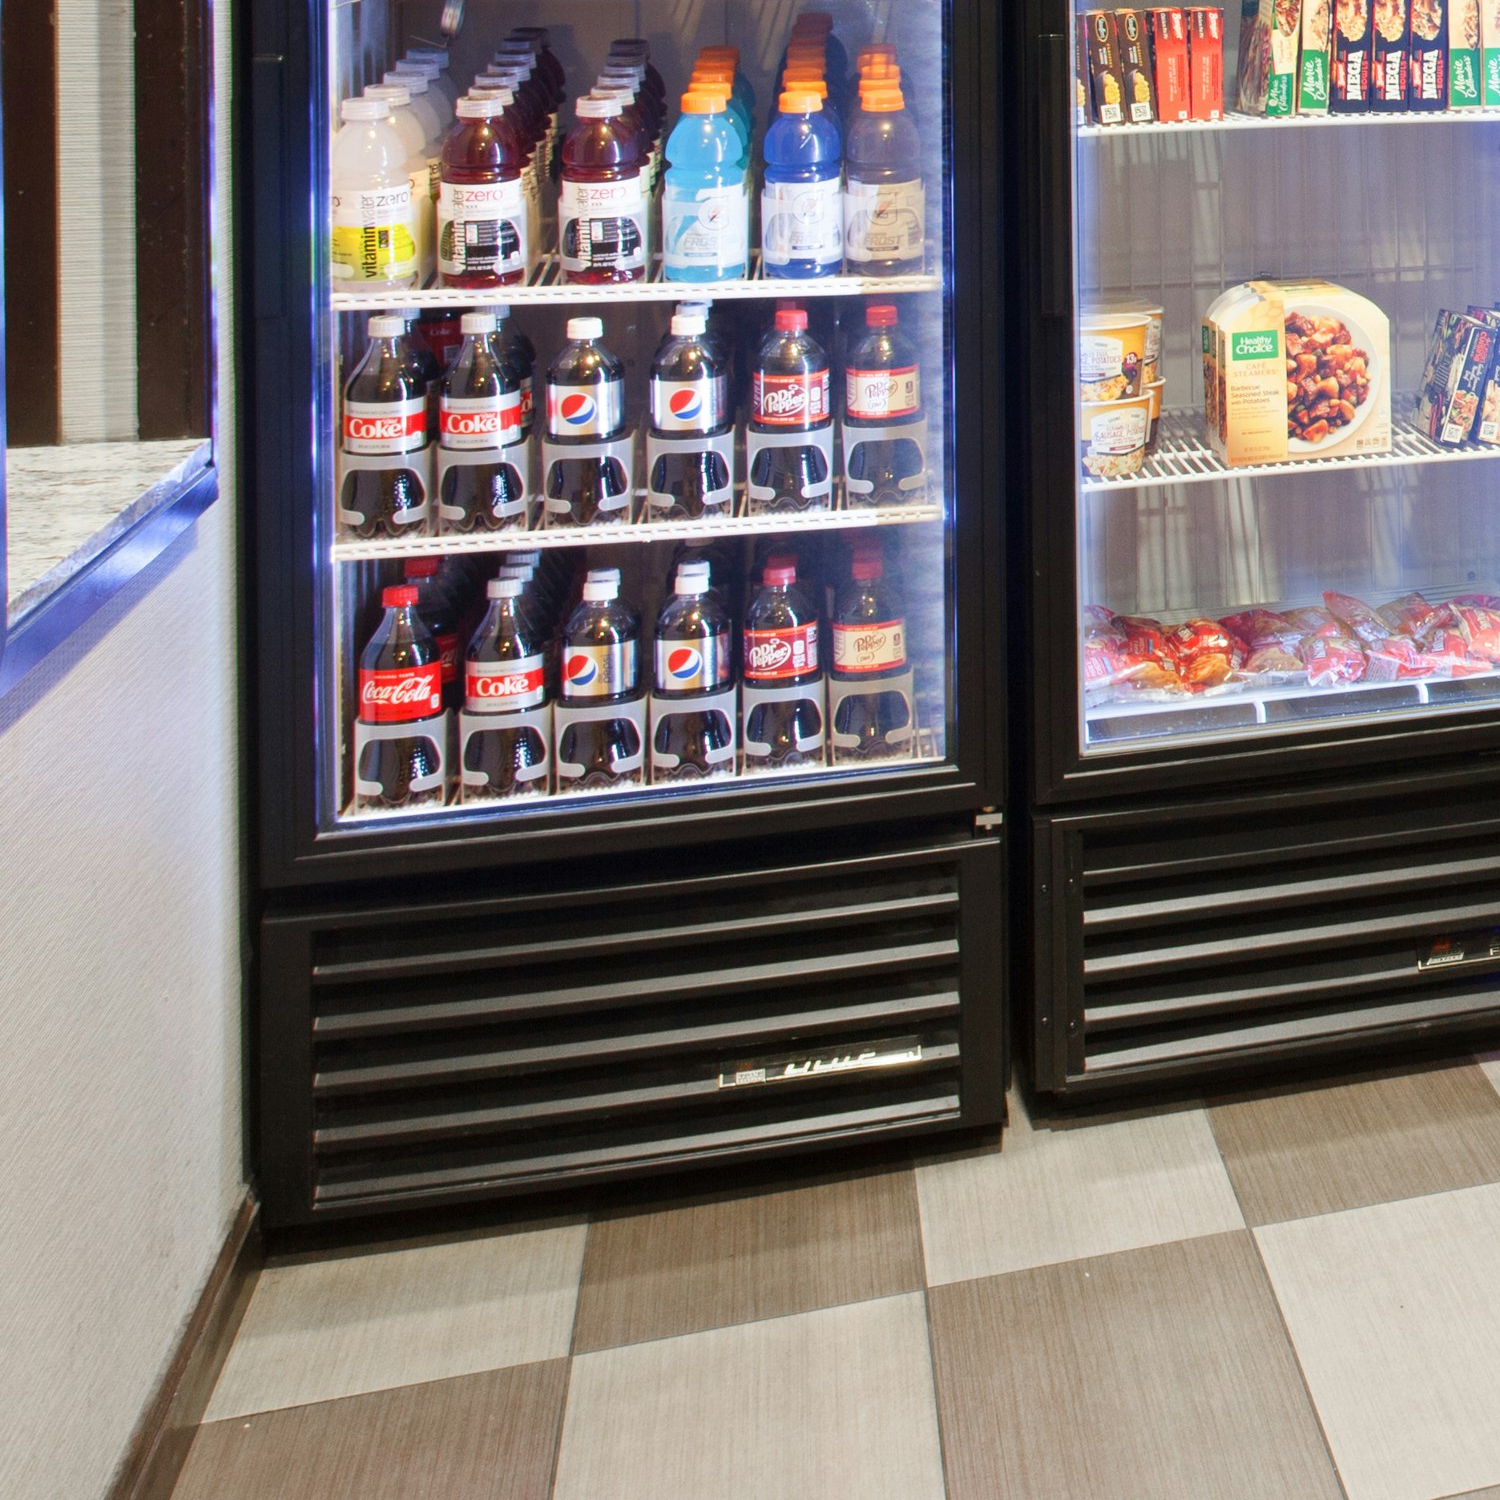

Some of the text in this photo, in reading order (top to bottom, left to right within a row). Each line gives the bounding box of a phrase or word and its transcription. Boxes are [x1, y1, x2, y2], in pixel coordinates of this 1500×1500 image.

[1347, 50, 1363, 100] MEGA
[1386, 50, 1401, 100] MEGA
[1423, 49, 1439, 99] MEGA
[1453, 59, 1466, 98] Marie
[1488, 58, 1500, 97] Marie
[465, 188, 504, 203] zero
[1235, 343, 1273, 354] Choice
[1240, 335, 1272, 345] Healthy
[350, 417, 402, 439] Coke
[447, 414, 500, 434] Coke
[361, 675, 434, 705] Coca-Cola
[475, 676, 528, 697] Coke
